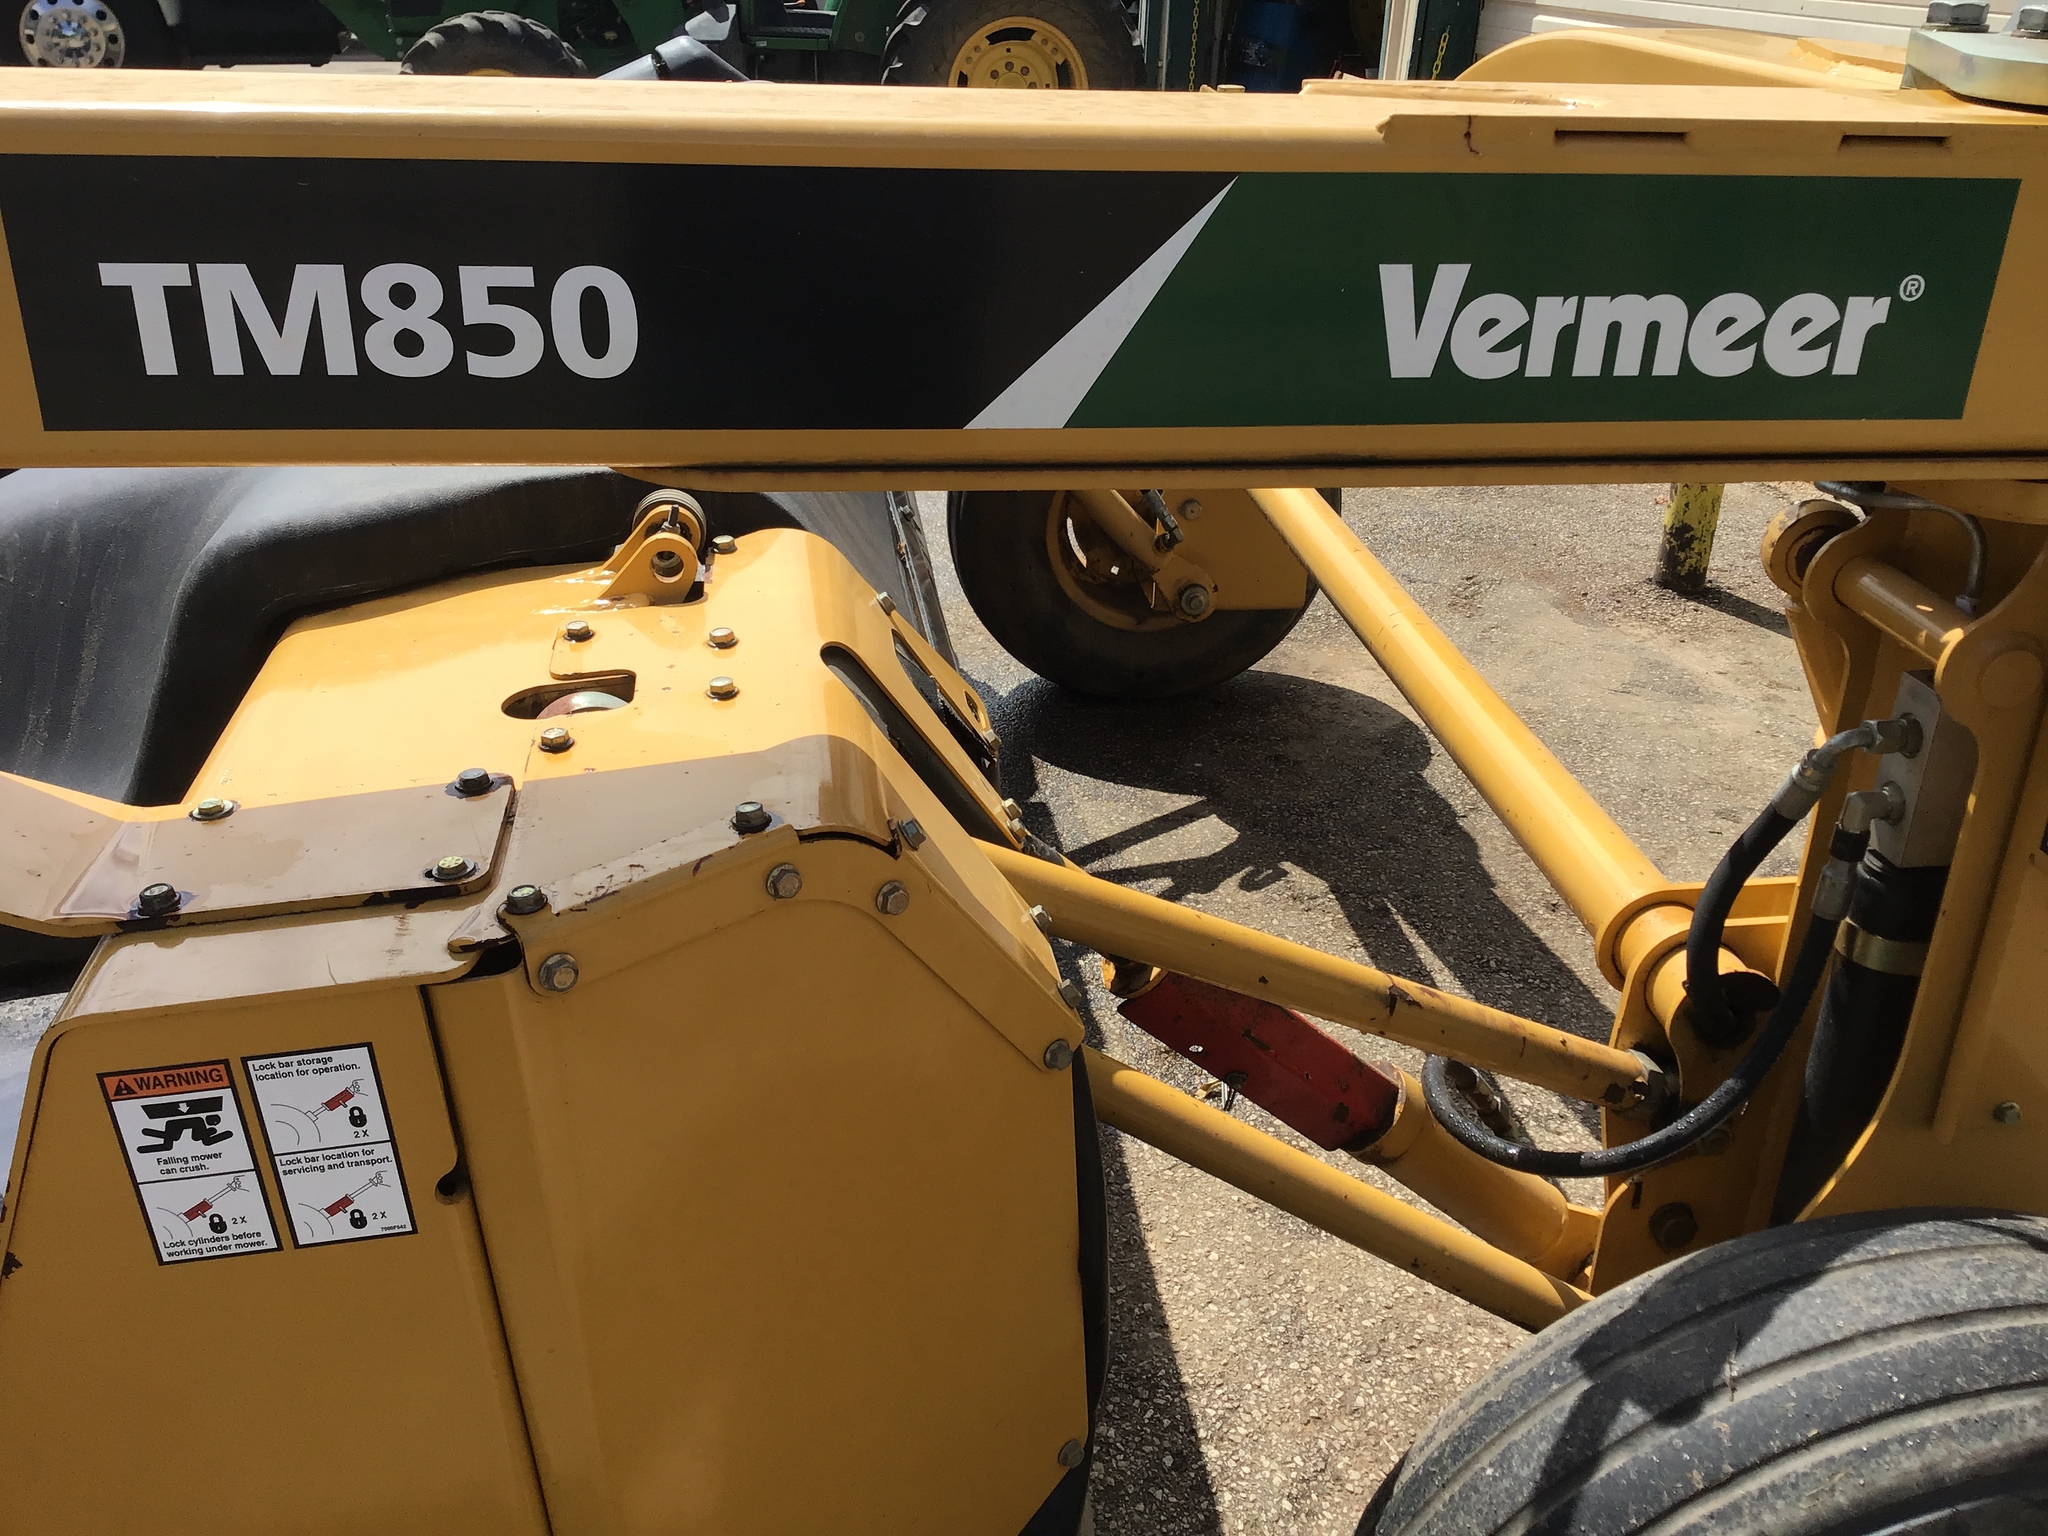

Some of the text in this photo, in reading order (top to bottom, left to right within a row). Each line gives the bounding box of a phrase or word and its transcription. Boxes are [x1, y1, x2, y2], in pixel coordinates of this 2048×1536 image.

[98, 262, 639, 379] TM850
[252, 1056, 333, 1072] Lock bar storage
[255, 1062, 360, 1081] location for operation.
[133, 1068, 224, 1091] WARNING
[353, 1130, 360, 1139] 2
[156, 1152, 223, 1166] Falling mower
[279, 1148, 375, 1167] Lock bar location for
[282, 1155, 392, 1176] servicing and transport.
[159, 1163, 209, 1175] can crush.
[231, 1217, 238, 1225] 2
[371, 1212, 378, 1220] 2
[163, 1231, 261, 1249] Lock cylinders before
[166, 1239, 268, 1258] working under mower.
